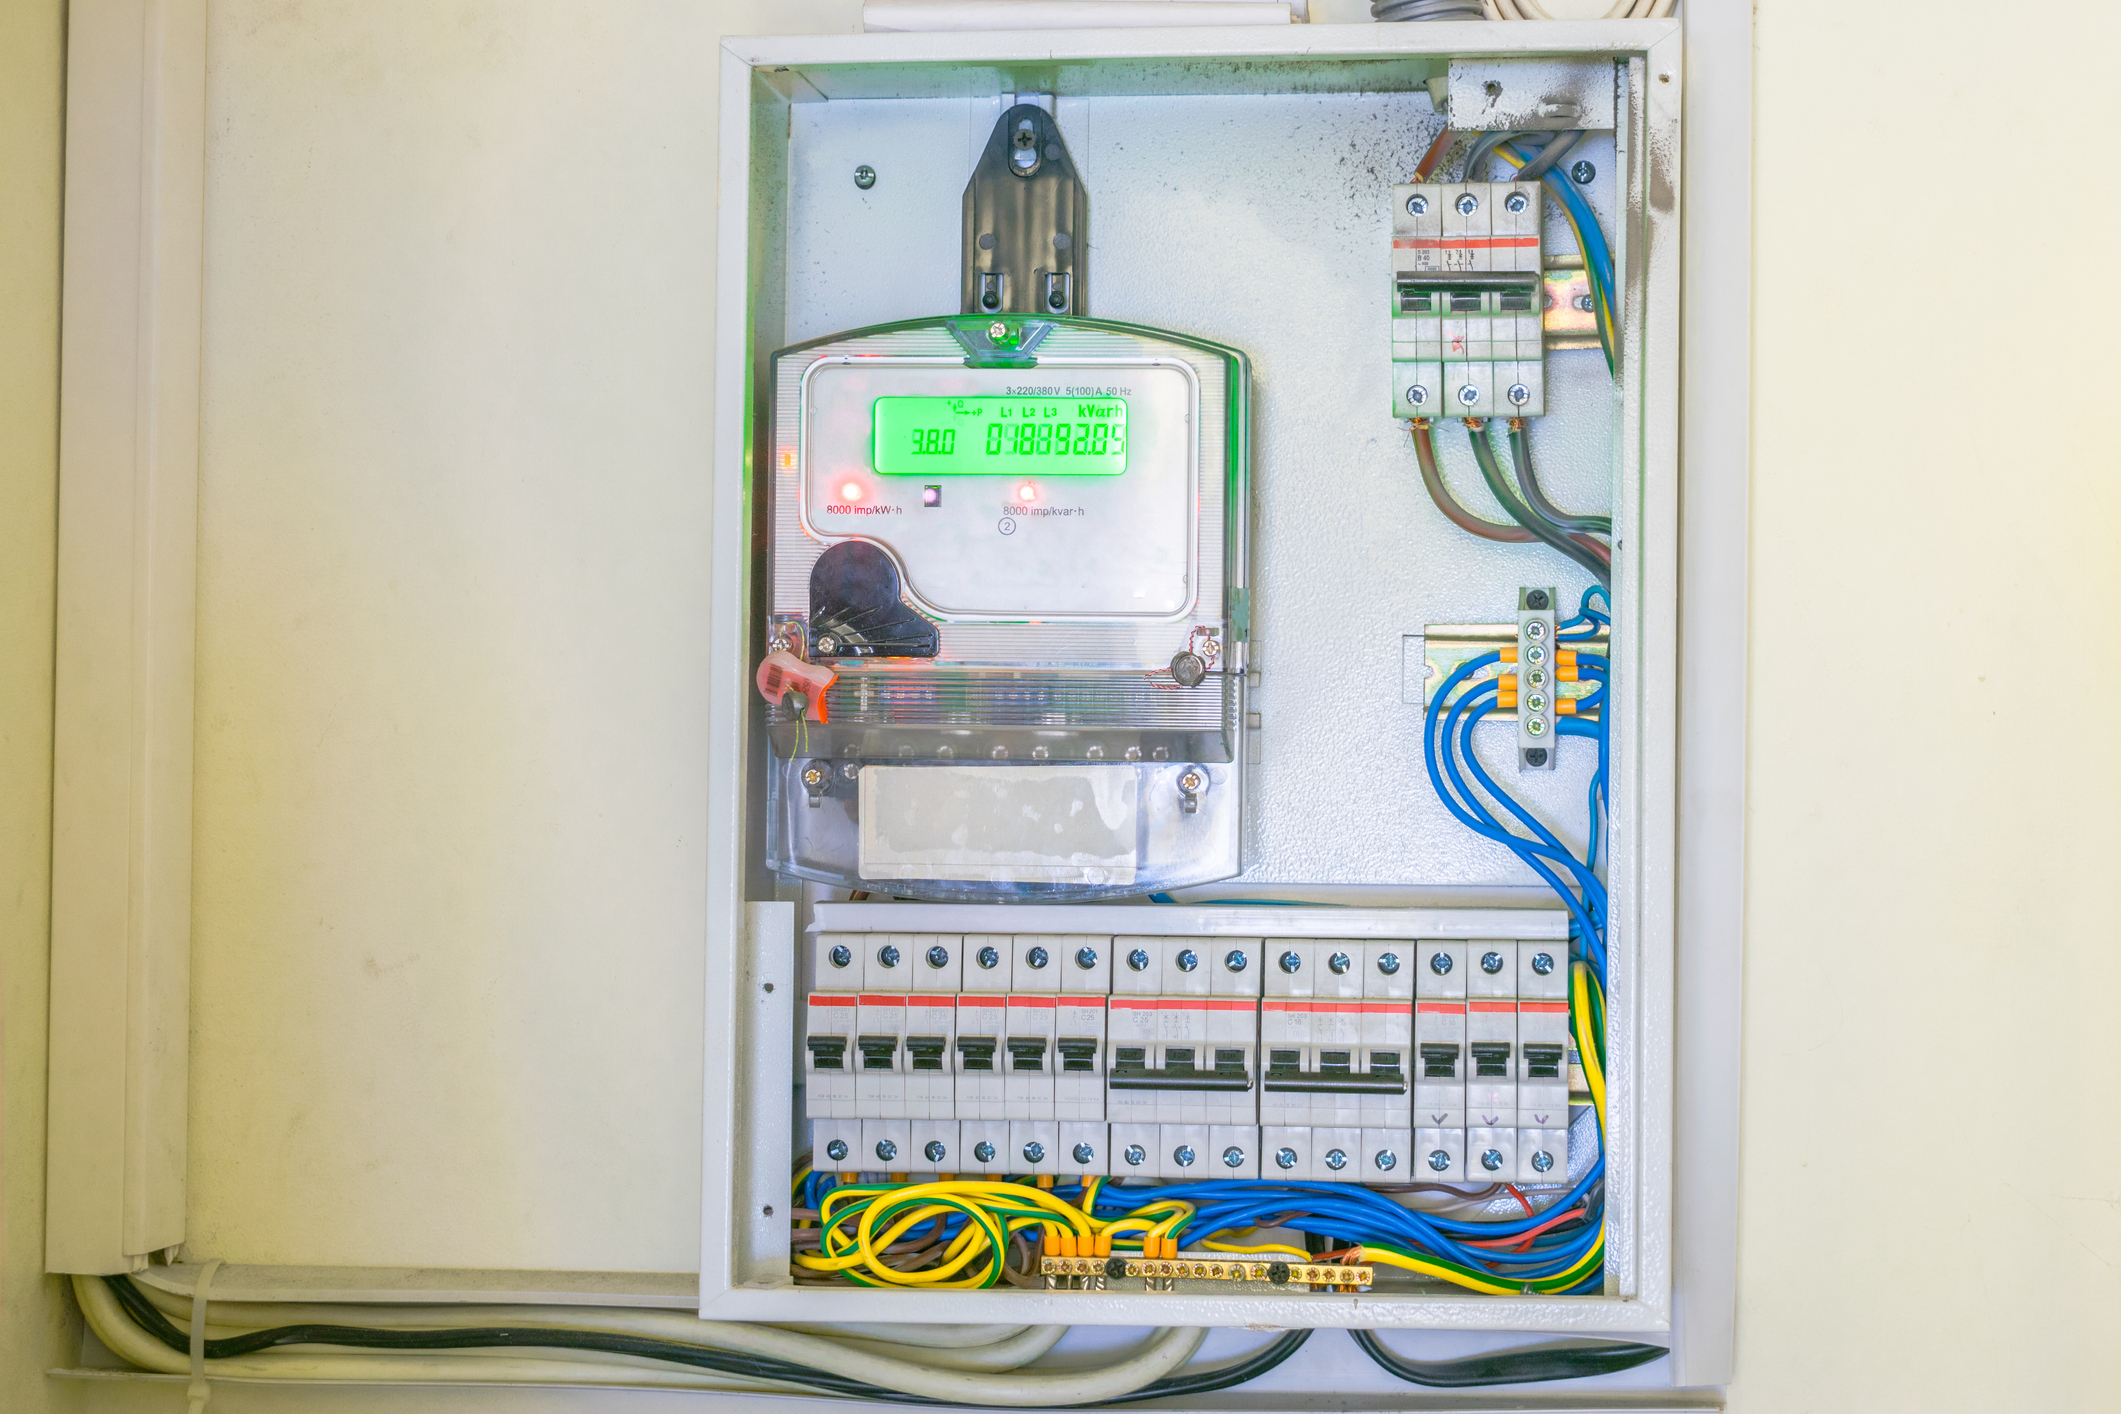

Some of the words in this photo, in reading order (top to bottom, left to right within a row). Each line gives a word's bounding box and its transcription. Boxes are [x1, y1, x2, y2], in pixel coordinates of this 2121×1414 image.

[1106, 387, 1117, 396] 50
[1120, 387, 1132, 396] Hz
[826, 505, 852, 515] 8000
[1003, 506, 1028, 516] 8000
